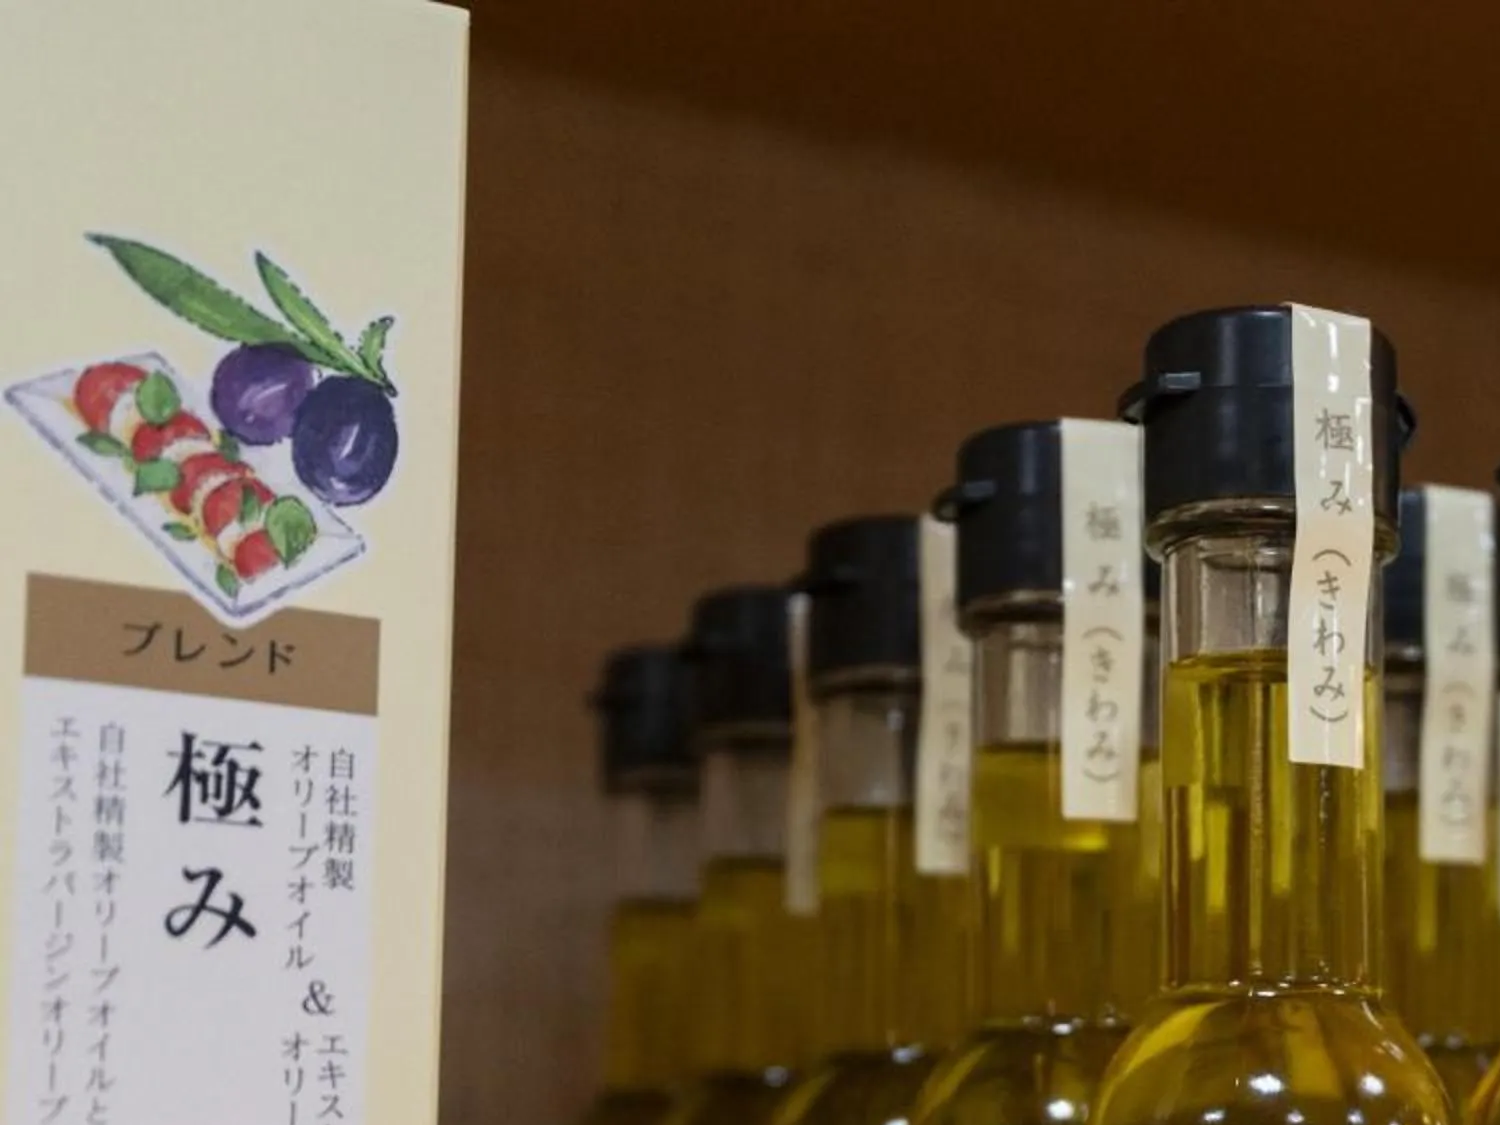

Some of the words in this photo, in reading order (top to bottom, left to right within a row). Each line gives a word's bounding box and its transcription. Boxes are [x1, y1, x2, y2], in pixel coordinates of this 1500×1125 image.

[122, 622, 296, 674] ブレンド
[163, 731, 264, 950] 極み
[284, 744, 319, 970] オリーブオイル
[323, 746, 358, 891] 自社精製
[302, 979, 336, 1016] &
